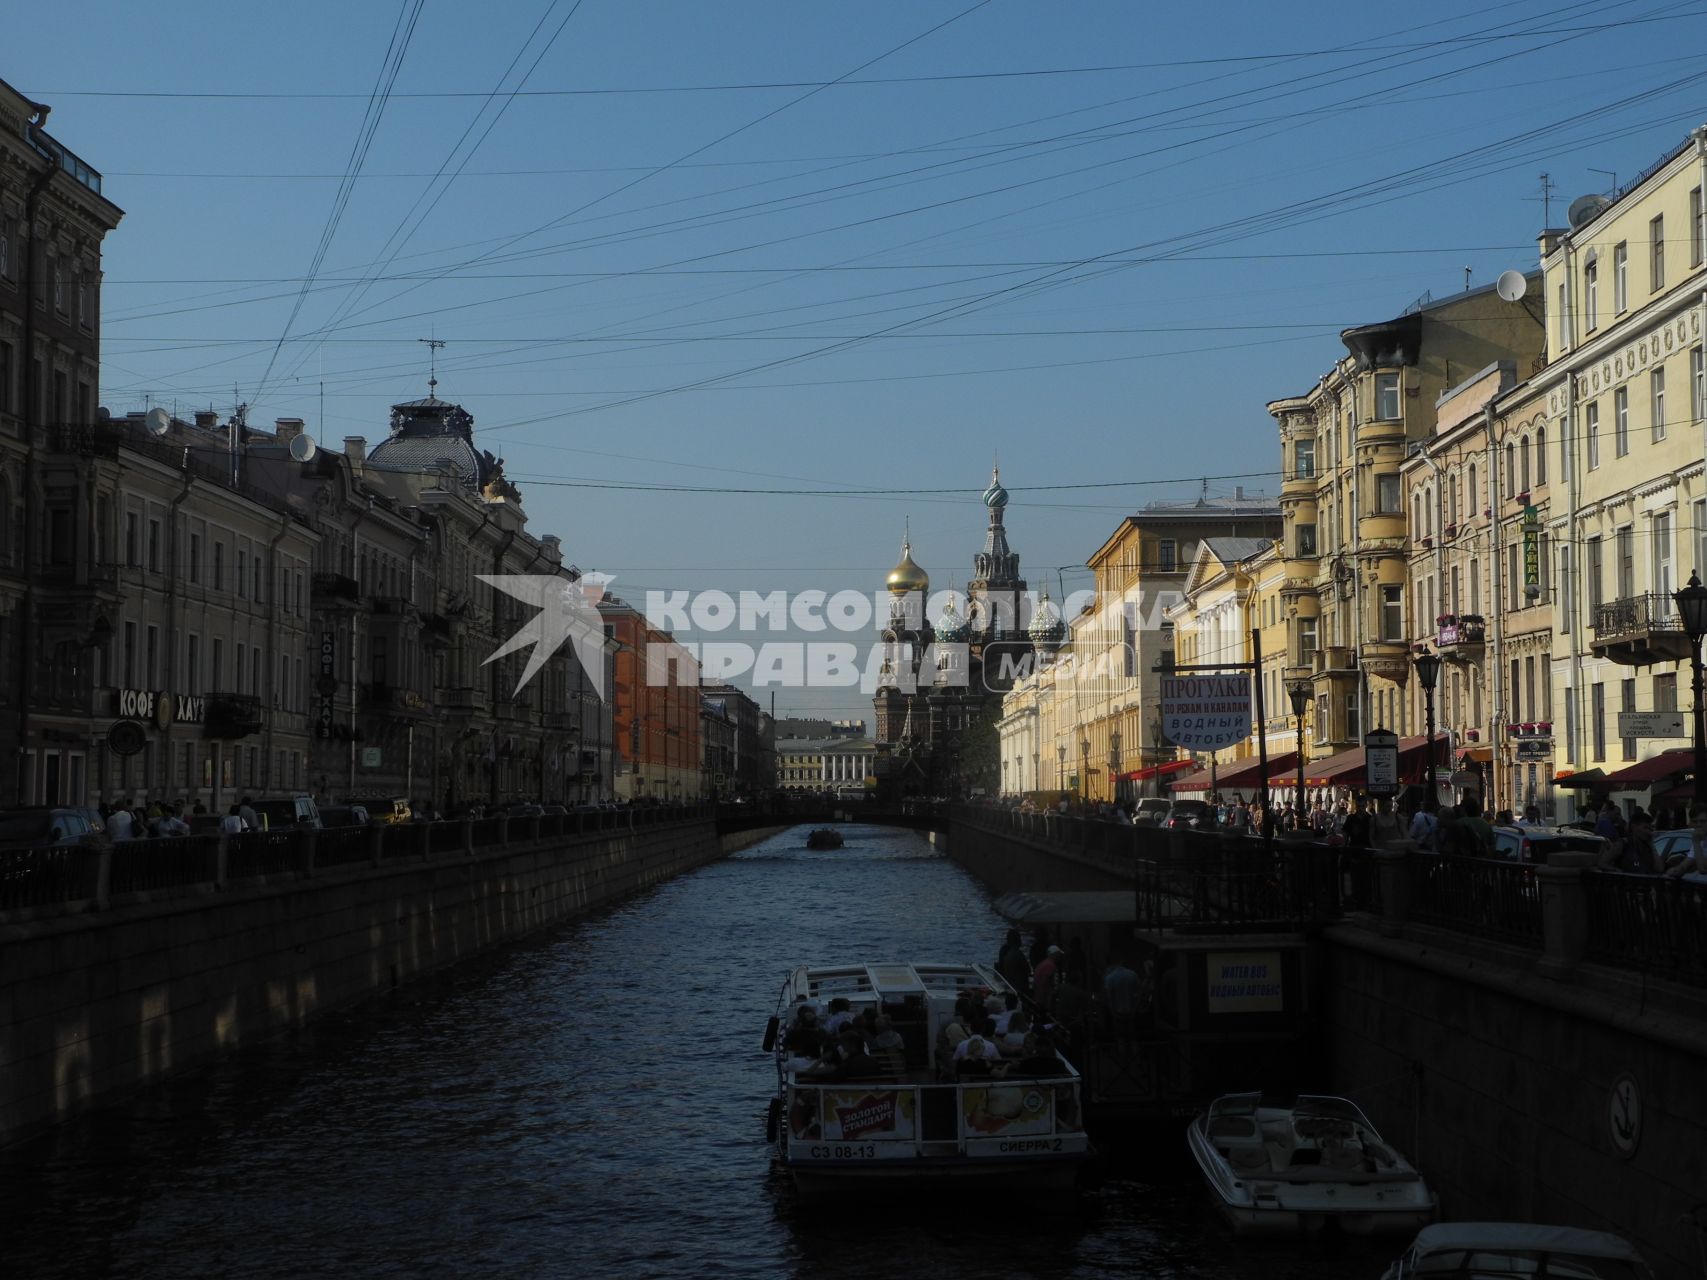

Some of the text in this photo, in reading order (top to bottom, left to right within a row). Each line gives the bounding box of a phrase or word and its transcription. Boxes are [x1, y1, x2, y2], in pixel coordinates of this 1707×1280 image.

[321, 632, 334, 674] КОФЕ
[1164, 677, 1249, 698] ПРОГУЛКИ
[120, 689, 205, 722] КОФЕ ХАУЗ
[1165, 703, 1175, 714] ПО
[1177, 703, 1202, 714] РЕКАМ
[1211, 702, 1249, 713] КАНАЛАМ
[321, 696, 333, 738] ХАУЗ
[1171, 716, 1243, 729] ВОДНЫЙ
[1171, 730, 1244, 744] АВТОБУС
[1222, 965, 1249, 978] WATER
[844, 1100, 891, 1124] ЗОЛОТОЙ
[843, 1110, 894, 1132] СТАНДАРТ
[835, 1146, 875, 1158] 08-13
[1000, 1138, 1063, 1152] СИЕРРА 2
